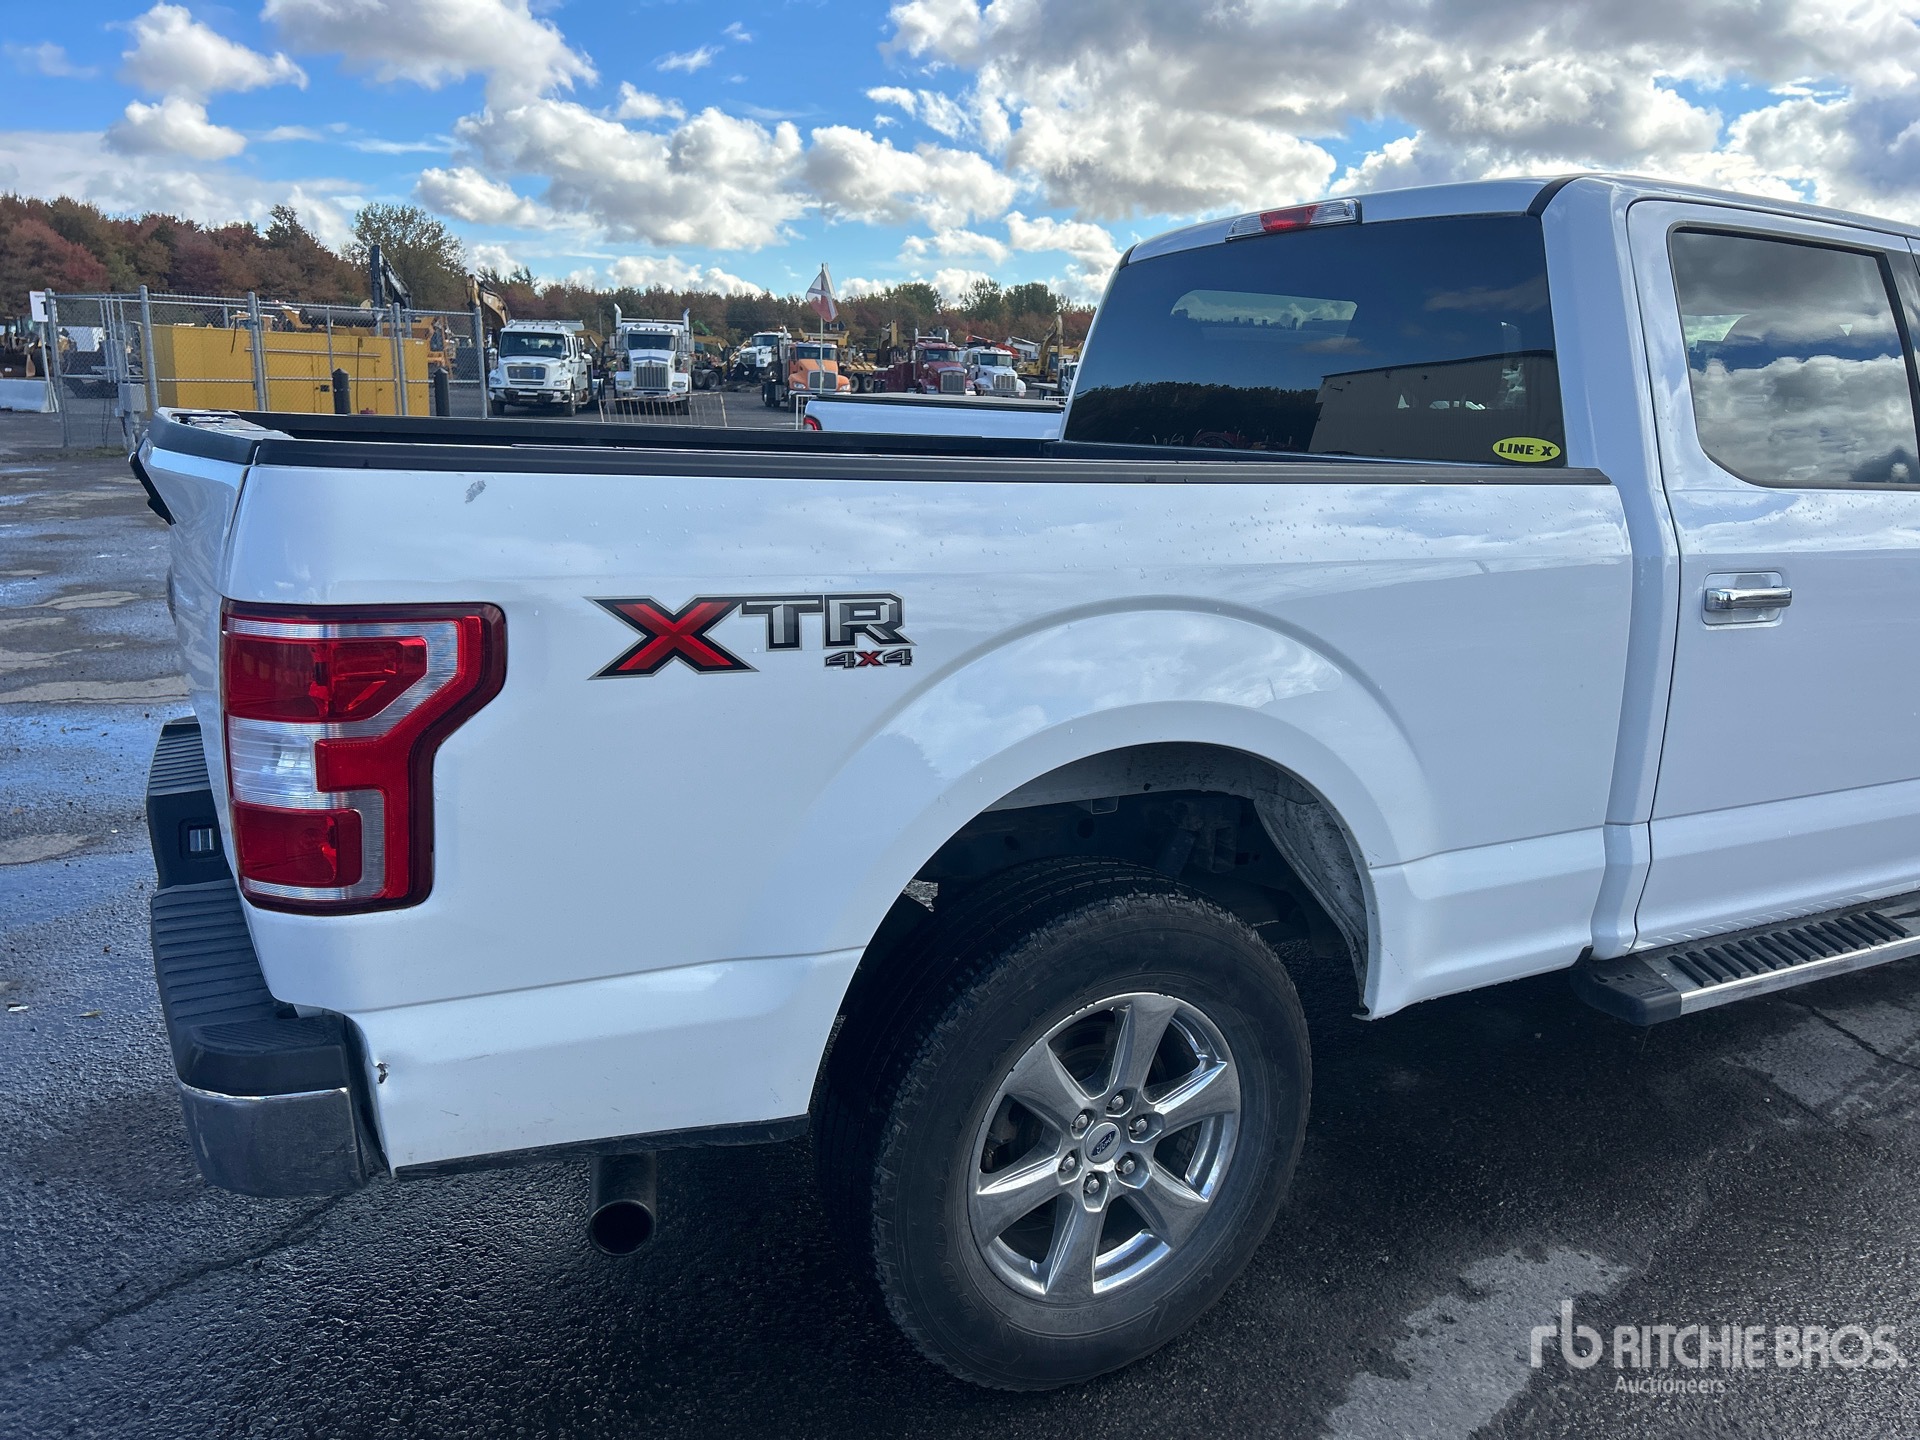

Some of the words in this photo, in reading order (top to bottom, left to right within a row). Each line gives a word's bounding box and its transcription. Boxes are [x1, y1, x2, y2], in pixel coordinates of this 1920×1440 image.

[1499, 443, 1553, 457] LINE-X
[583, 592, 917, 681] XTR
[1094, 1132, 1114, 1155] Ford
